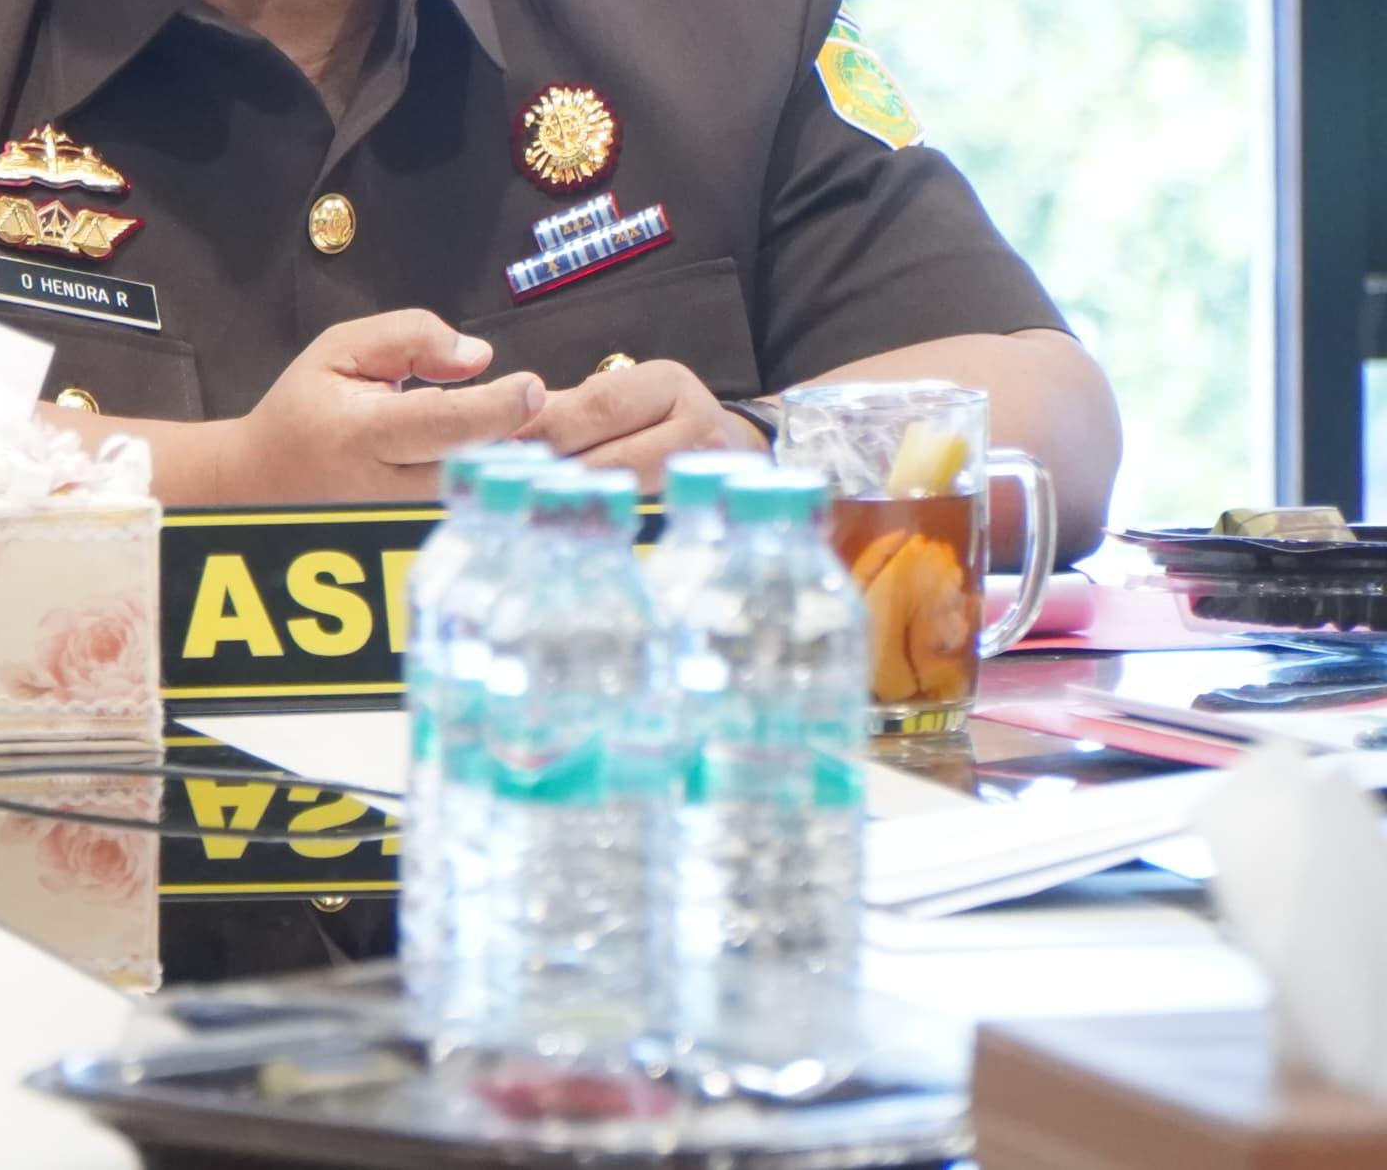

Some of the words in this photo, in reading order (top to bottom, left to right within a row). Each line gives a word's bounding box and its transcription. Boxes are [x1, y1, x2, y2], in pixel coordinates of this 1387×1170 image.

[21, 273, 33, 290] O
[41, 277, 110, 305] HENDRA
[116, 290, 129, 308] R
